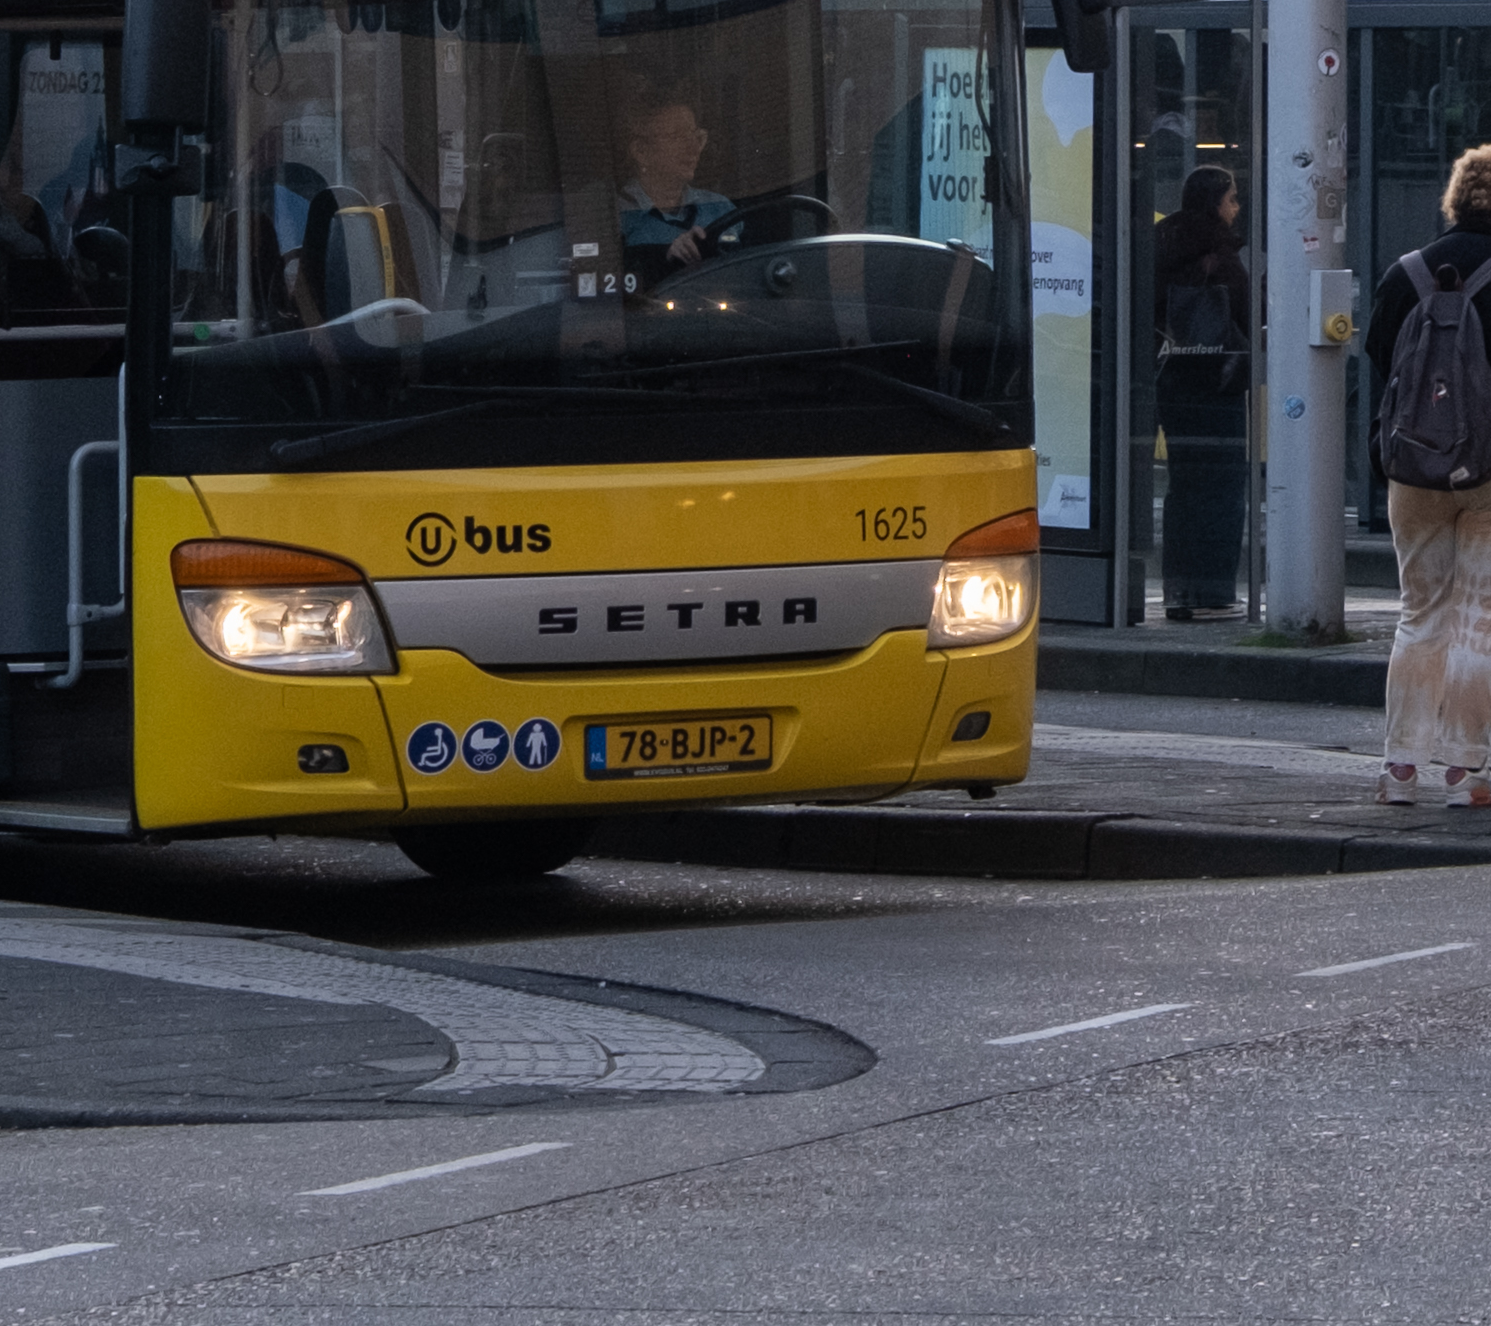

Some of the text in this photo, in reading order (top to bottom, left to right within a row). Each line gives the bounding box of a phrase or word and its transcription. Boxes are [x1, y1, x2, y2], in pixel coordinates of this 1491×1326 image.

[932, 62, 972, 99] Hoe
[929, 173, 978, 202] voor
[1326, 193, 1337, 207] G
[463, 515, 552, 554] bus
[854, 507, 928, 543] 1625
[538, 597, 817, 636] SETRA
[619, 725, 756, 763] 78-BJP-2
